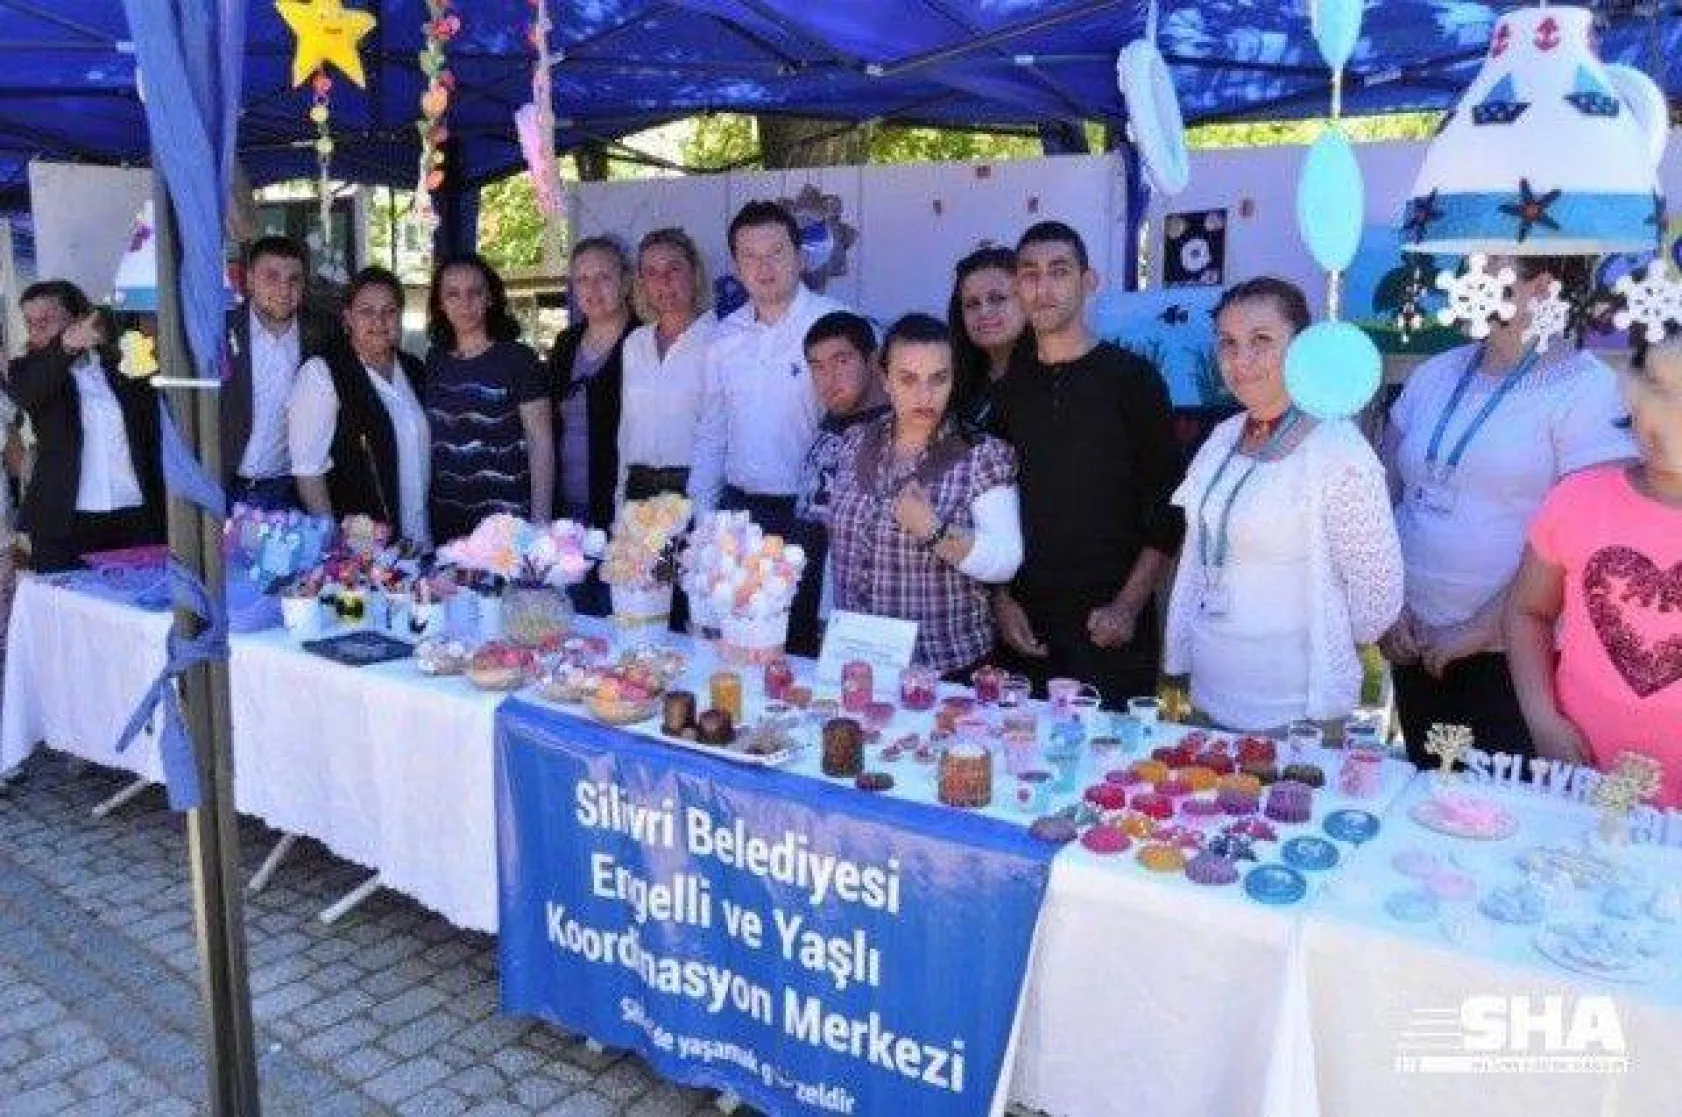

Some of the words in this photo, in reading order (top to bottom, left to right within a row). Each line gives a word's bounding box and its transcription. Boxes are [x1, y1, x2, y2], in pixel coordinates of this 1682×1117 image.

[576, 780, 674, 847] Silivri
[687, 806, 900, 914] Belediyesi
[545, 900, 773, 1025] Koordnasyon
[783, 986, 966, 1094] Merkezi
[722, 899, 763, 948] ve
[773, 908, 881, 989] Yaşlı
